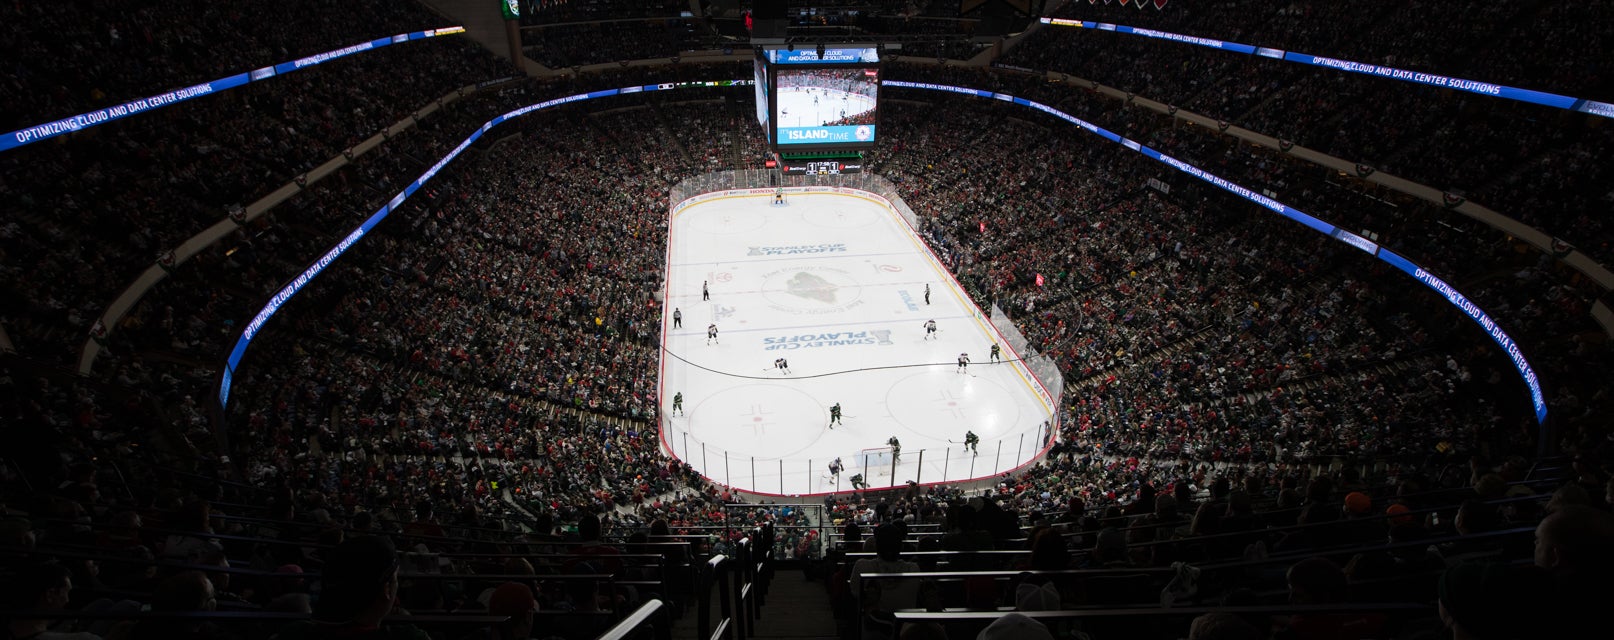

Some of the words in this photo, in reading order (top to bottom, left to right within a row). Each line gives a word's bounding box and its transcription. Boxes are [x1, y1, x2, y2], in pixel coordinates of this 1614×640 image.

[1199, 38, 1222, 46] SOLUTIONS
[1313, 56, 1350, 70] OPTIMIZING
[1350, 62, 1374, 73] CLOUD
[1375, 66, 1391, 76] AND
[1392, 69, 1412, 80] DATA
[1414, 73, 1446, 86] CENTER
[1448, 79, 1500, 94] SOLUTIONS
[16, 119, 77, 143] OPTIMIZING
[79, 111, 108, 126] CLOUD
[109, 106, 127, 118] AND
[128, 101, 148, 113] DATA
[150, 94, 176, 107] CENTER
[177, 84, 212, 100] SOLUTIONS
[789, 130, 828, 139] ISLAND
[1160, 154, 1186, 170] OPTIMIZING
[1185, 165, 1201, 176] CLOUD
[1202, 172, 1214, 182] AND
[1214, 177, 1228, 188] DATA
[1228, 182, 1250, 198] CENTER
[1250, 192, 1285, 212] SOLUTIONS
[766, 247, 847, 255] PLAYOFFS
[243, 301, 275, 340] OPTIMIZING
[273, 286, 294, 306] CLOUD
[294, 275, 307, 290] AND
[306, 263, 321, 279] DATA
[321, 249, 340, 267] CENTER
[340, 227, 364, 251] SOLUTIONS
[764, 331, 866, 344] PLAYOFFS
[803, 338, 875, 350] STANLEY
[1414, 268, 1456, 300] OPTIMIZING
[1456, 294, 1480, 318] CLOUD
[1479, 314, 1494, 331] AND
[1492, 326, 1509, 348] DATA
[1508, 343, 1528, 374] CENTER
[1524, 368, 1544, 411] SOLUTIONS
[764, 343, 800, 351] CUP
